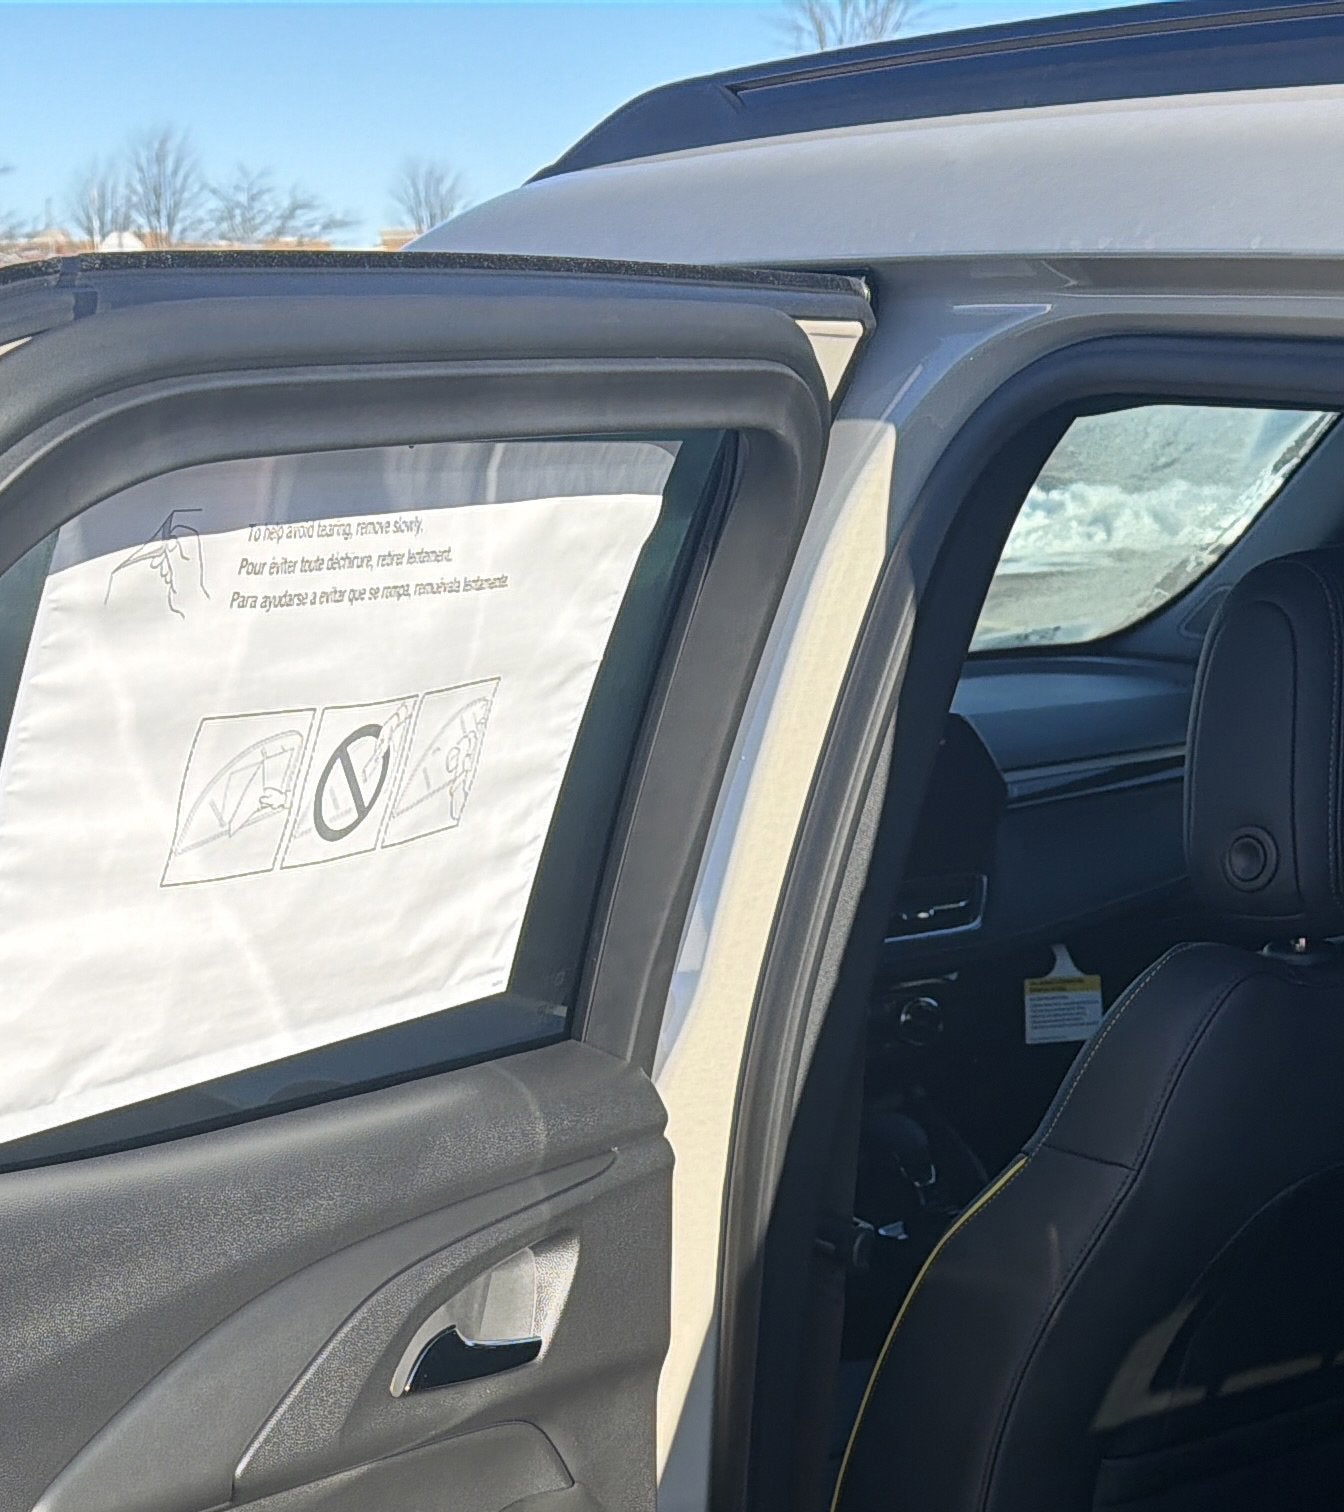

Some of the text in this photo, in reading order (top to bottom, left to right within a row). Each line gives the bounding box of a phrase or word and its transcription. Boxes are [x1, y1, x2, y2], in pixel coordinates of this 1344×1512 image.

[248, 523, 262, 542] To
[356, 521, 391, 536] remove
[238, 557, 268, 575] Pour
[299, 556, 325, 573] toute
[229, 591, 258, 609] Para
[259, 590, 309, 613] ayudarse
[309, 592, 318, 606] a
[348, 587, 367, 606] que
[367, 586, 380, 601] se
